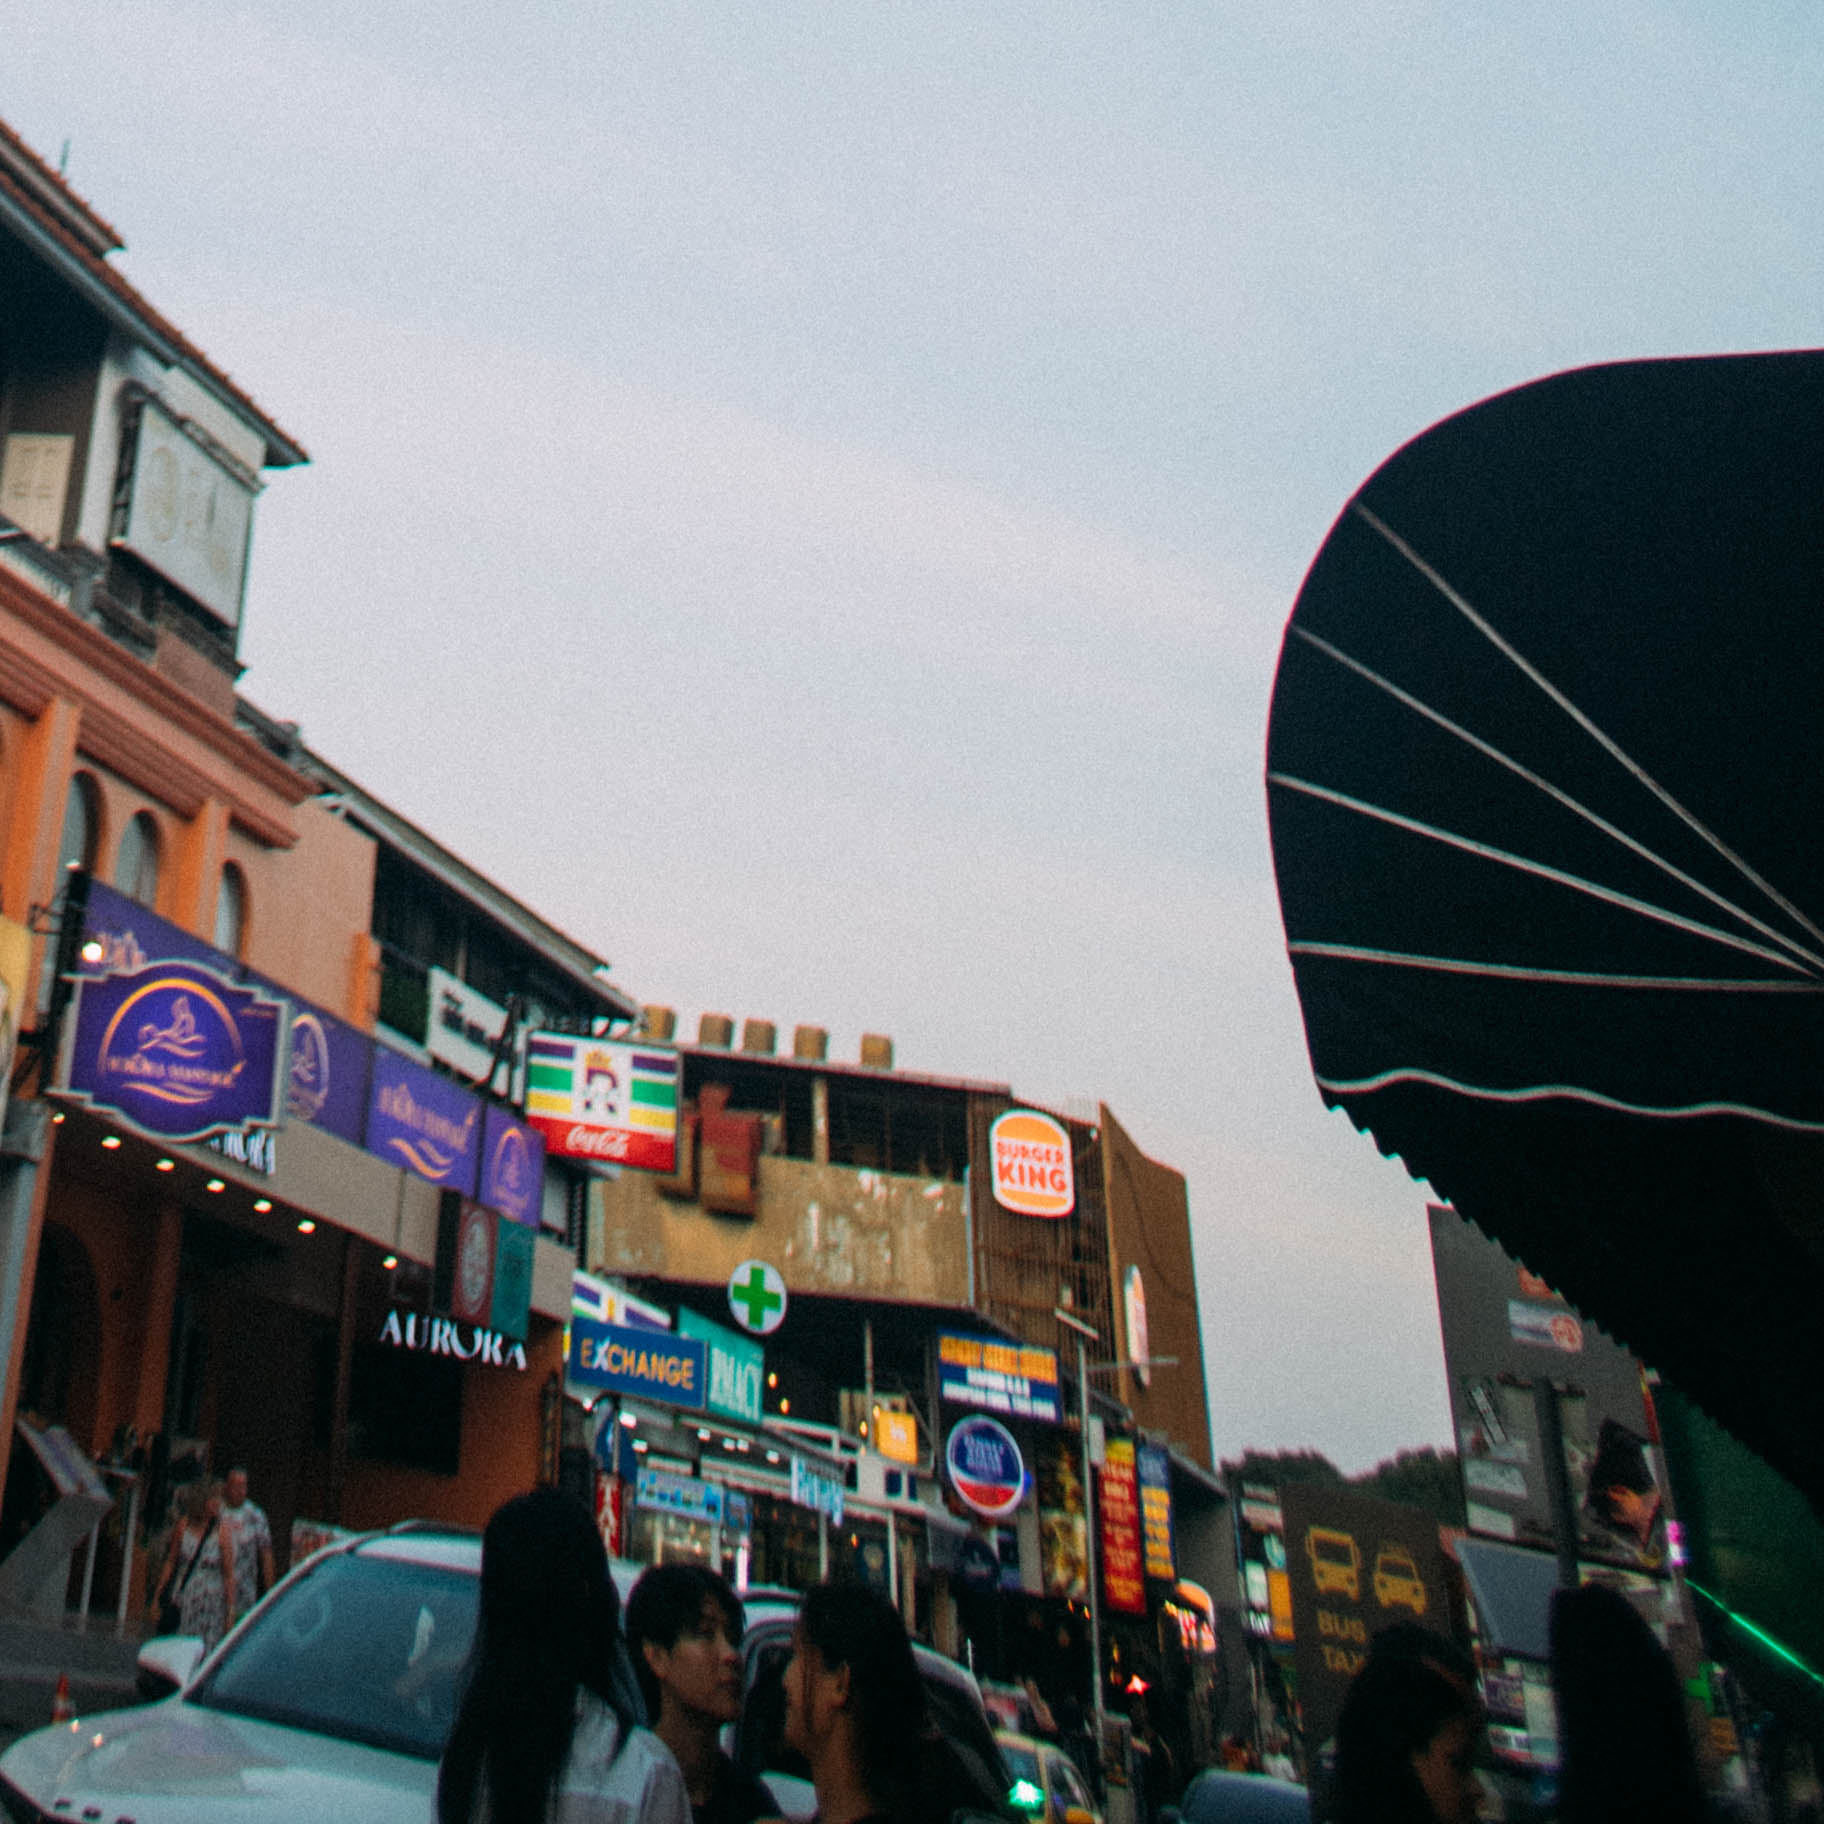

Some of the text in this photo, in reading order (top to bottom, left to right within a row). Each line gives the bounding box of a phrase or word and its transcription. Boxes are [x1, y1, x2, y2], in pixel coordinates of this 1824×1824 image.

[996, 1139, 1065, 1166] BURGER
[997, 1160, 1068, 1193] KING
[378, 1309, 527, 1371] AURORA
[580, 1336, 694, 1392] EXCHANGE
[1316, 1609, 1367, 1644] BUS
[1322, 1645, 1367, 1678] TAX
